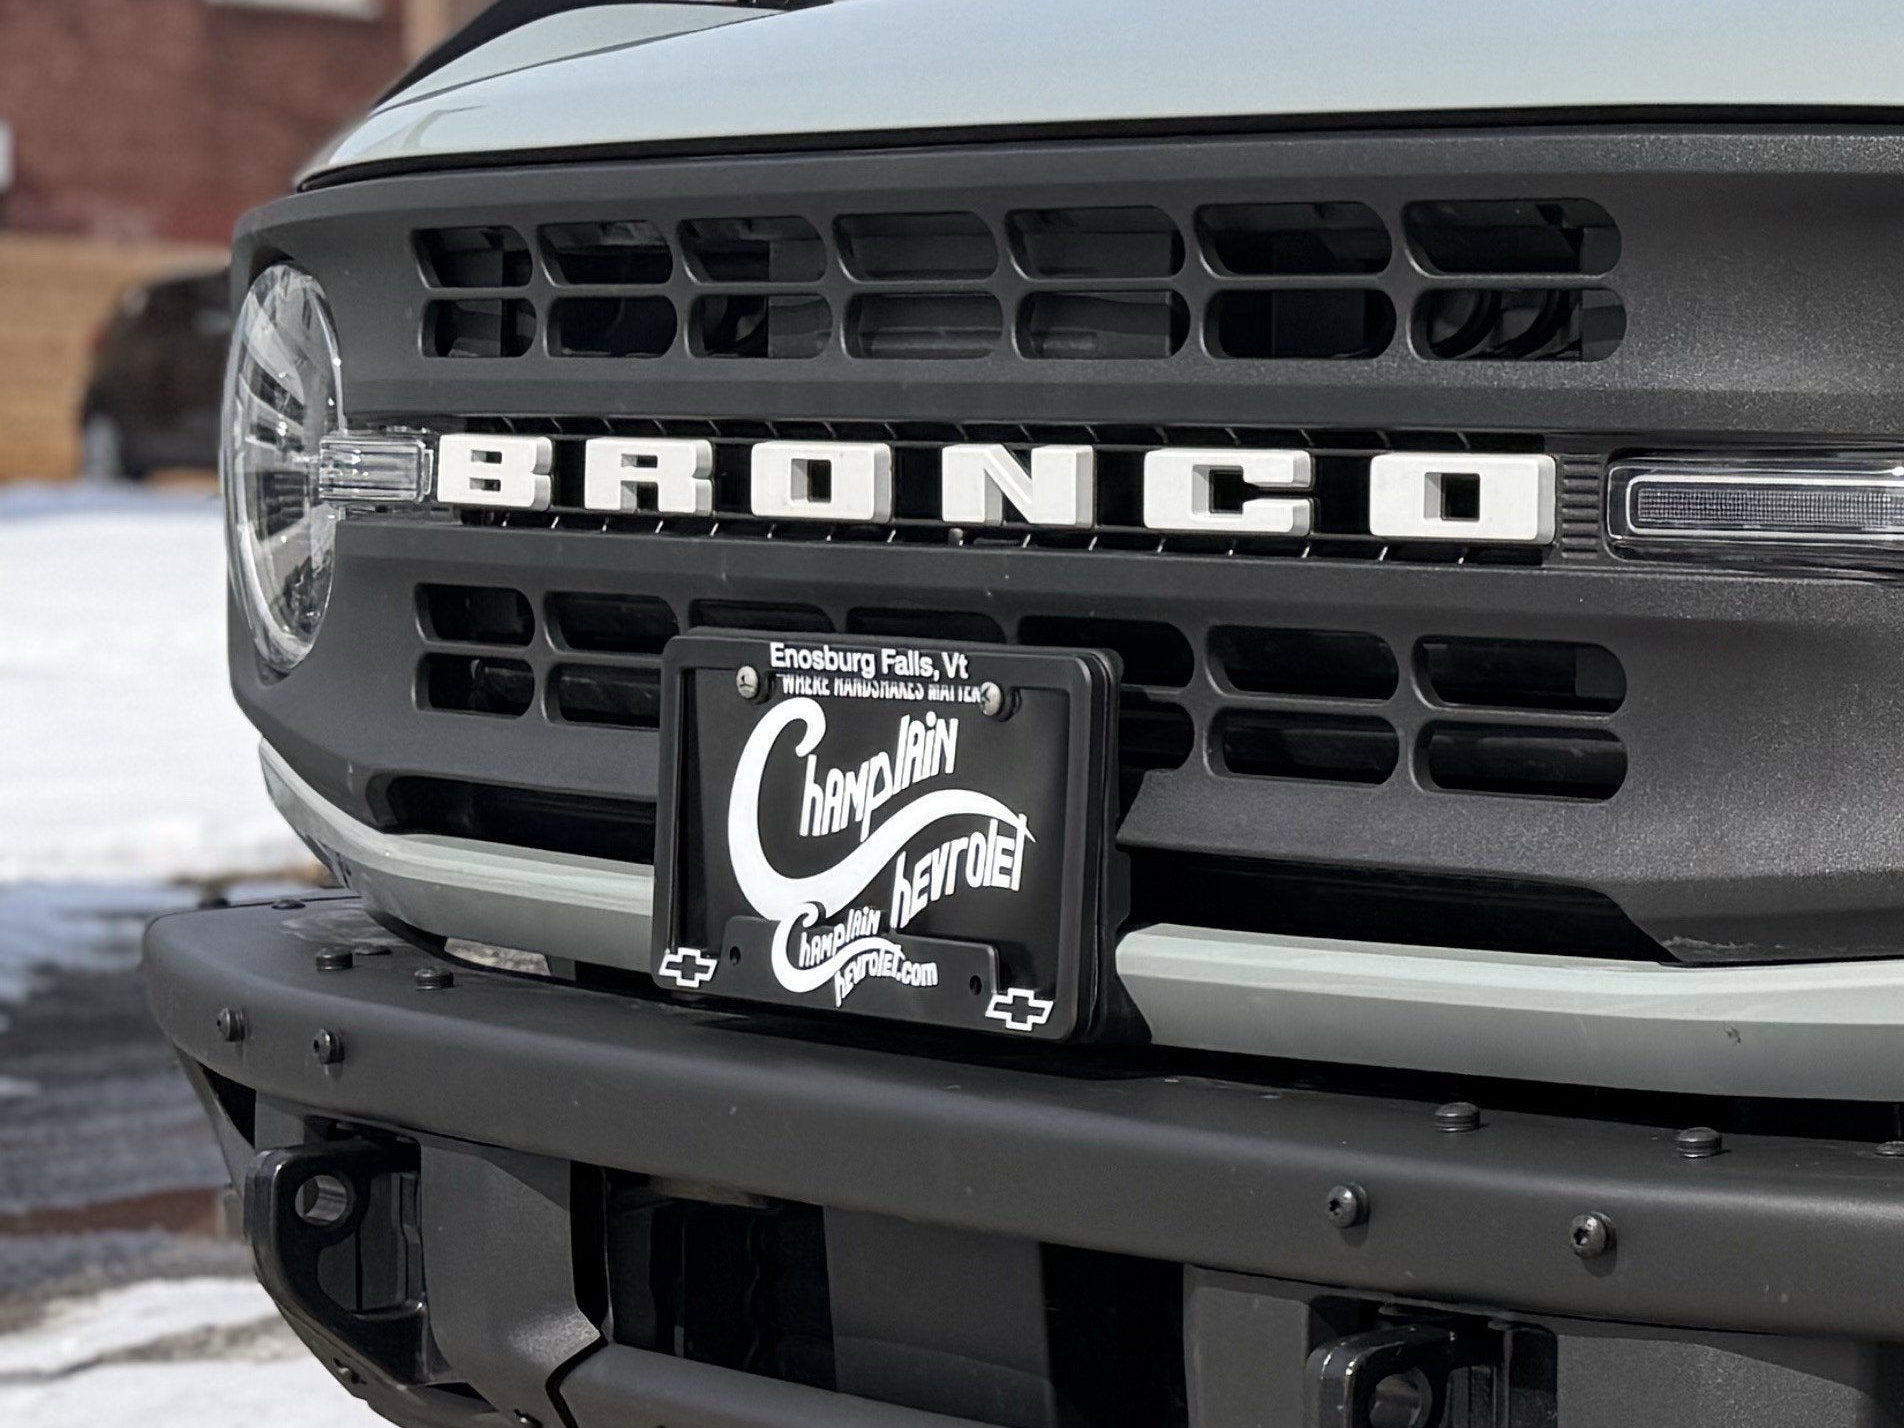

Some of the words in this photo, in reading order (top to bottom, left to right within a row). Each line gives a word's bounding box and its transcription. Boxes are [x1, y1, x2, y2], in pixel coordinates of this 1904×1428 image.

[437, 433, 1557, 545] BRONCO
[769, 641, 875, 679] Enosburg
[881, 648, 940, 682] Falls,
[942, 652, 969, 680] Vt
